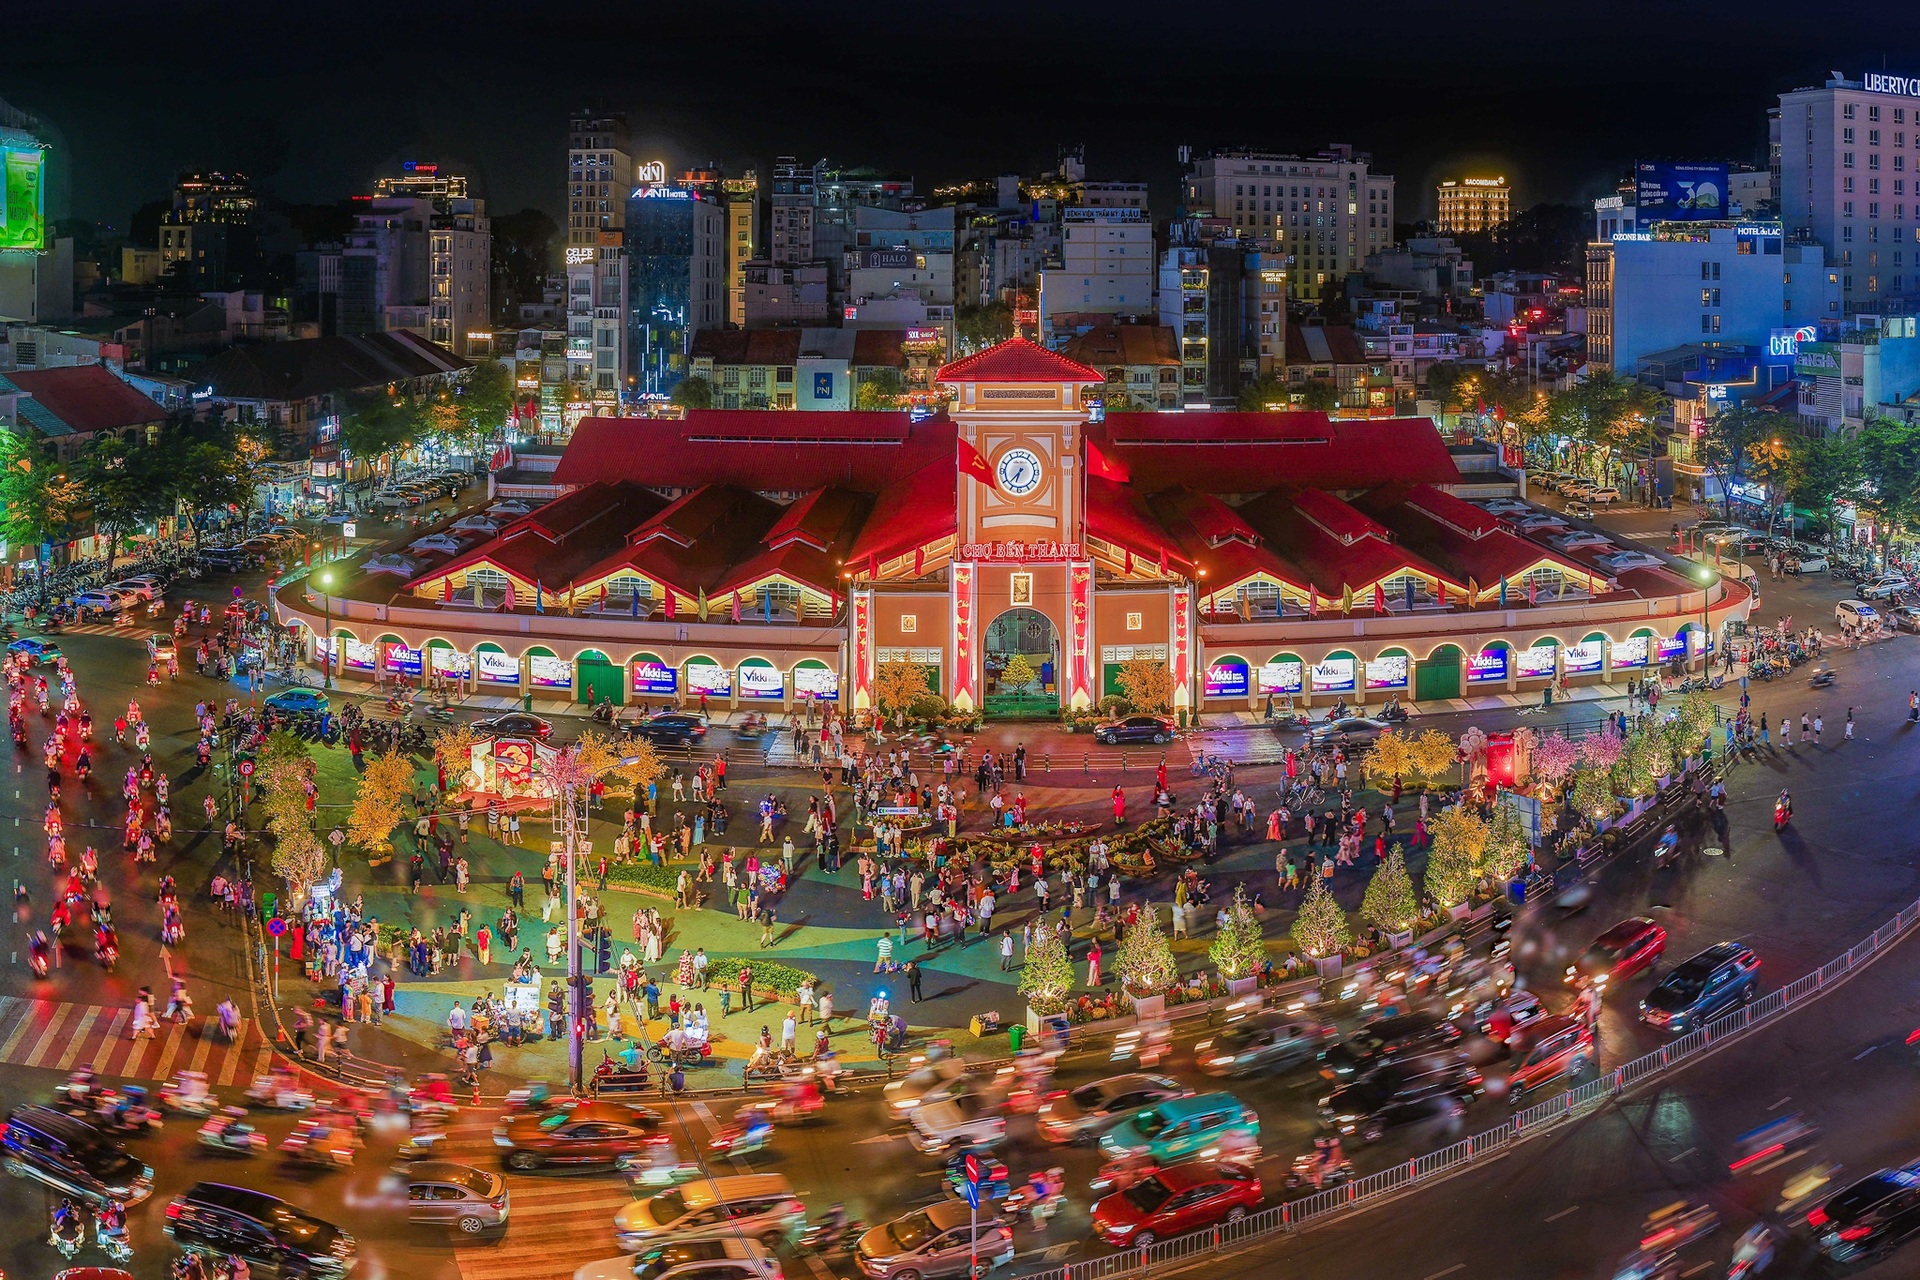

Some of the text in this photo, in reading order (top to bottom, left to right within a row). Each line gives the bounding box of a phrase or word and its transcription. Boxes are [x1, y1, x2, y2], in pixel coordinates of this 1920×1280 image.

[1864, 72, 1908, 94] LIBERTY
[632, 188, 669, 198] AVANTI
[566, 256, 581, 264] SPA
[817, 387, 829, 396] PNJ
[963, 540, 1080, 560] CHỢ BẾN THÀNH
[388, 645, 410, 660] Vikki
[1567, 647, 1588, 659] Vikki
[483, 654, 505, 667] Vikki
[1470, 653, 1492, 667] Vikki
[637, 663, 661, 678] Vikki
[743, 669, 767, 682] Vikki
[1207, 667, 1232, 681] Vikki
[1316, 663, 1338, 676] Vikki
